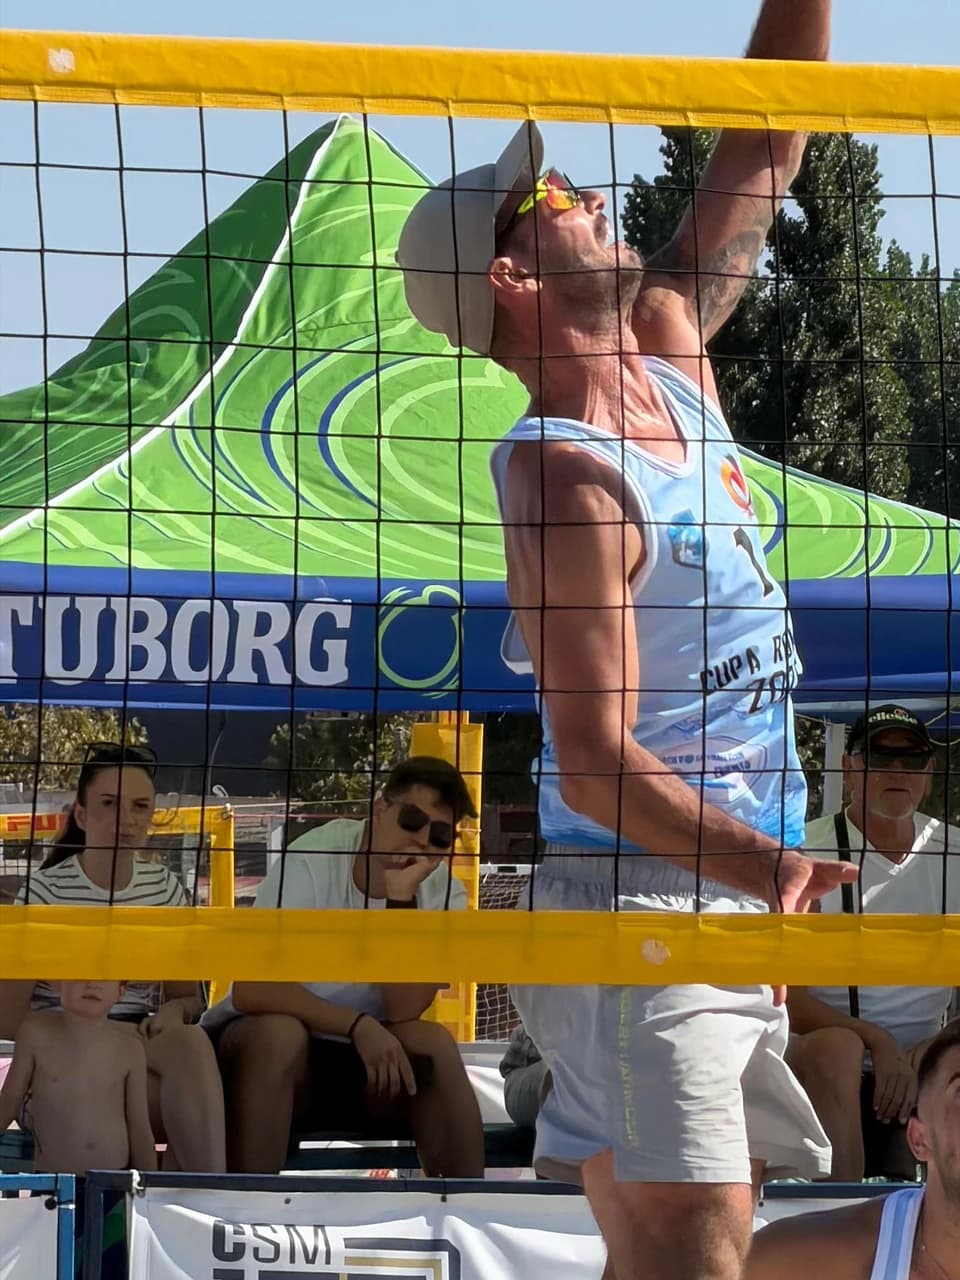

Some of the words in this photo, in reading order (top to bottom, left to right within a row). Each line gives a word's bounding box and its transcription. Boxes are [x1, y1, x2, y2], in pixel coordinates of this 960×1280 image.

[0, 595, 352, 686] TUBORG
[700, 647, 760, 696] CUPA
[212, 1219, 331, 1265] CSM
